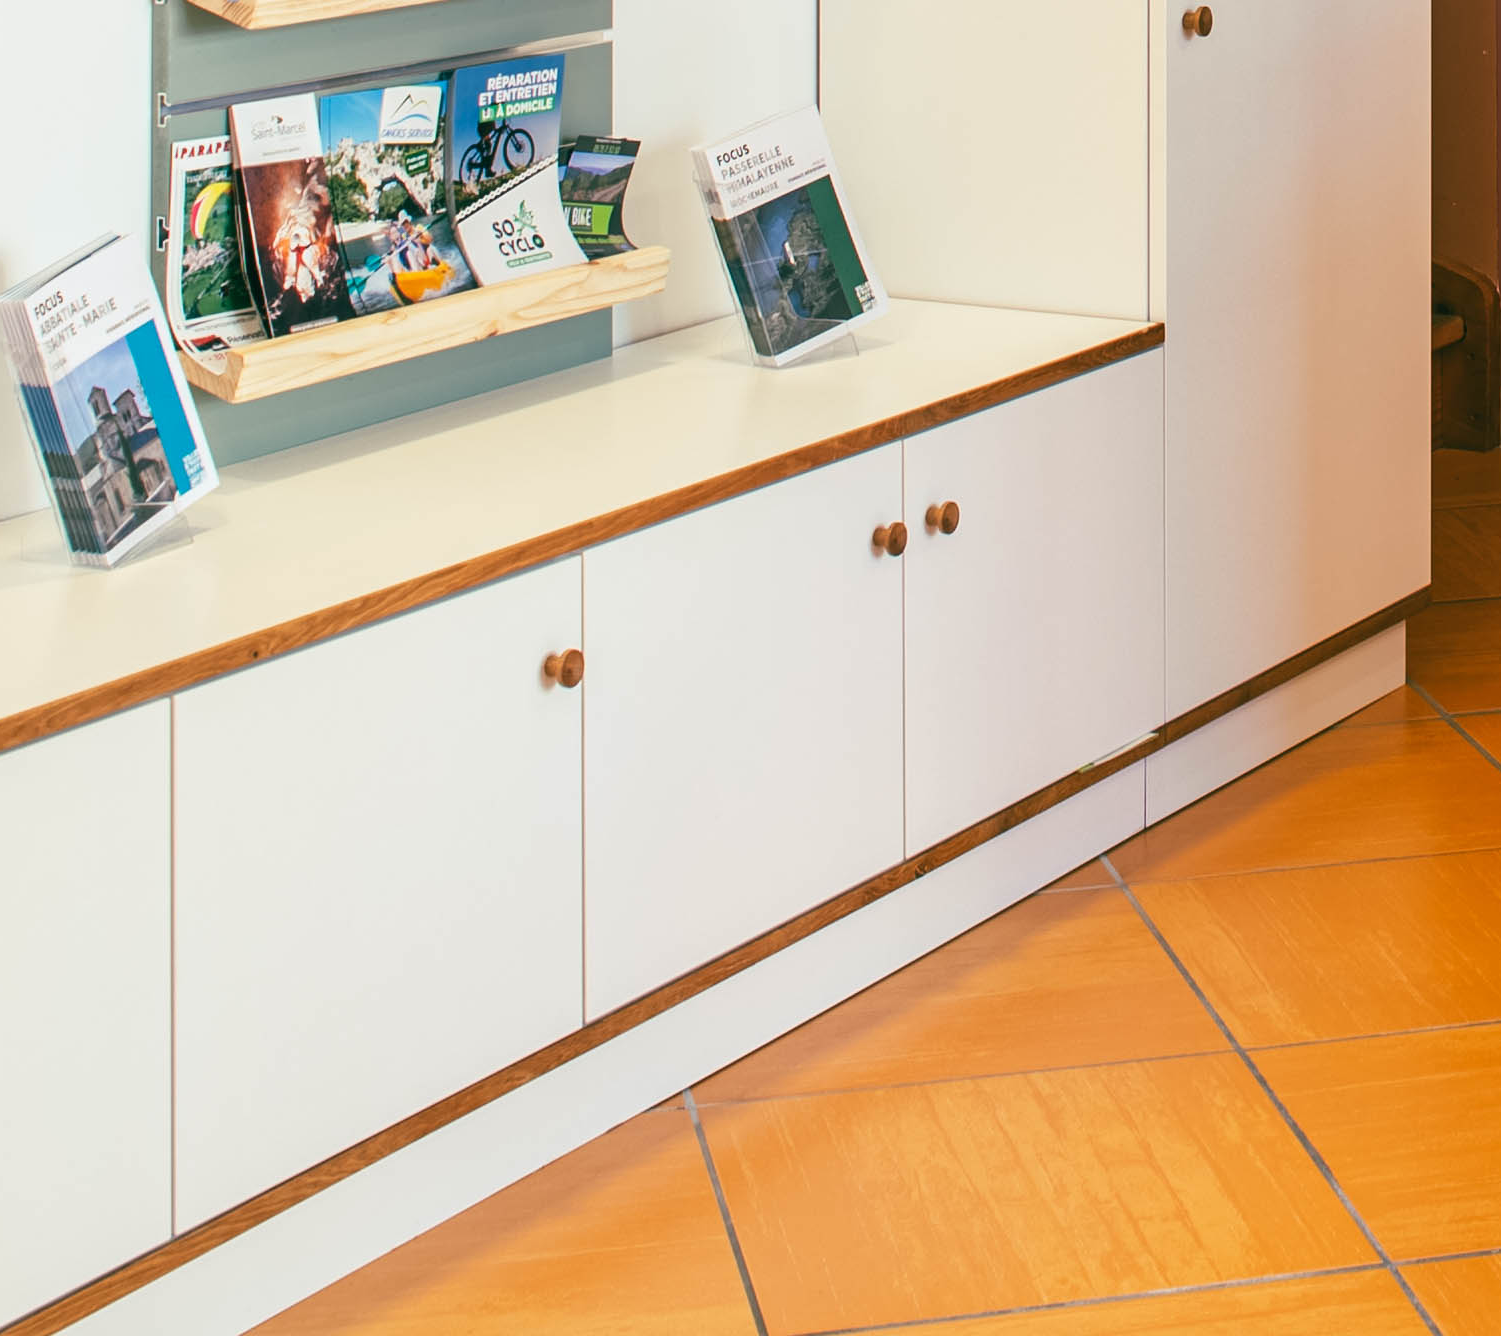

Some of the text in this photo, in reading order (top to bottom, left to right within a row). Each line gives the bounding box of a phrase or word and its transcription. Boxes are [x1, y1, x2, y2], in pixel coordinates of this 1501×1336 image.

[487, 68, 559, 92] RÉPARATION
[478, 82, 557, 107] ET ENTRETIEN
[495, 97, 555, 117] À DOMICILE
[716, 143, 751, 167] FOCUS
[720, 144, 784, 181] PASSERELLE
[572, 207, 593, 226] BIKE
[492, 218, 515, 240] SO
[499, 233, 546, 257] CYCLO
[34, 289, 65, 320] FOCUS
[39, 293, 91, 336] ABBATIALE
[82, 296, 118, 332] MARIE
